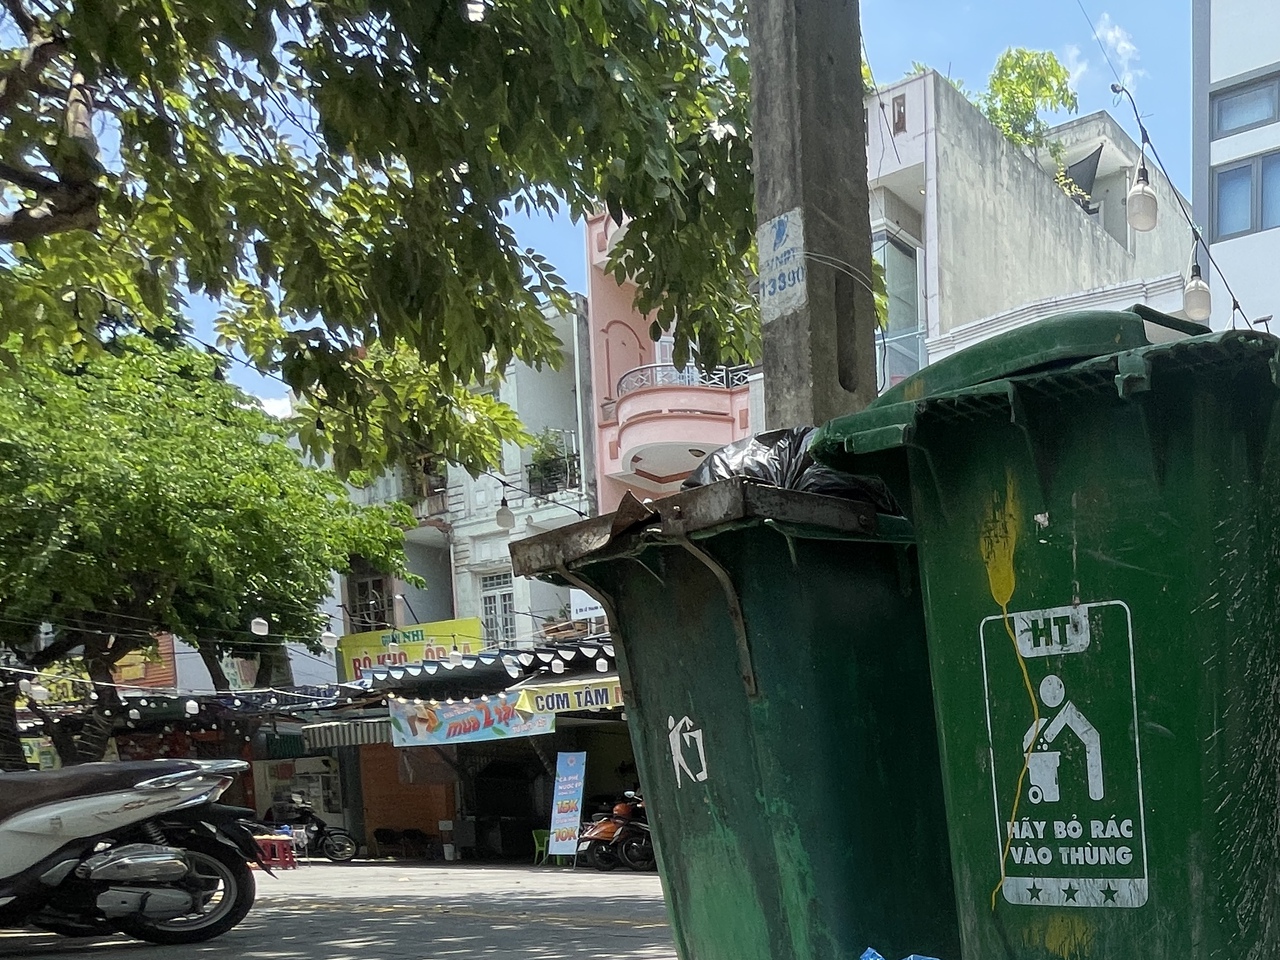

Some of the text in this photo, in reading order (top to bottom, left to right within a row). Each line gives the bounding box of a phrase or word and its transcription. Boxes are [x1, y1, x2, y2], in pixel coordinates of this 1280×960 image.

[403, 629, 425, 643] NHI
[1031, 615, 1070, 648] HT
[535, 692, 570, 712] CƠM
[556, 799, 578, 814] 15K
[555, 826, 577, 842] 10K
[1006, 813, 1133, 839] HÃY BỎ RÁC
[1010, 841, 1134, 865] VÀO THÙNG
